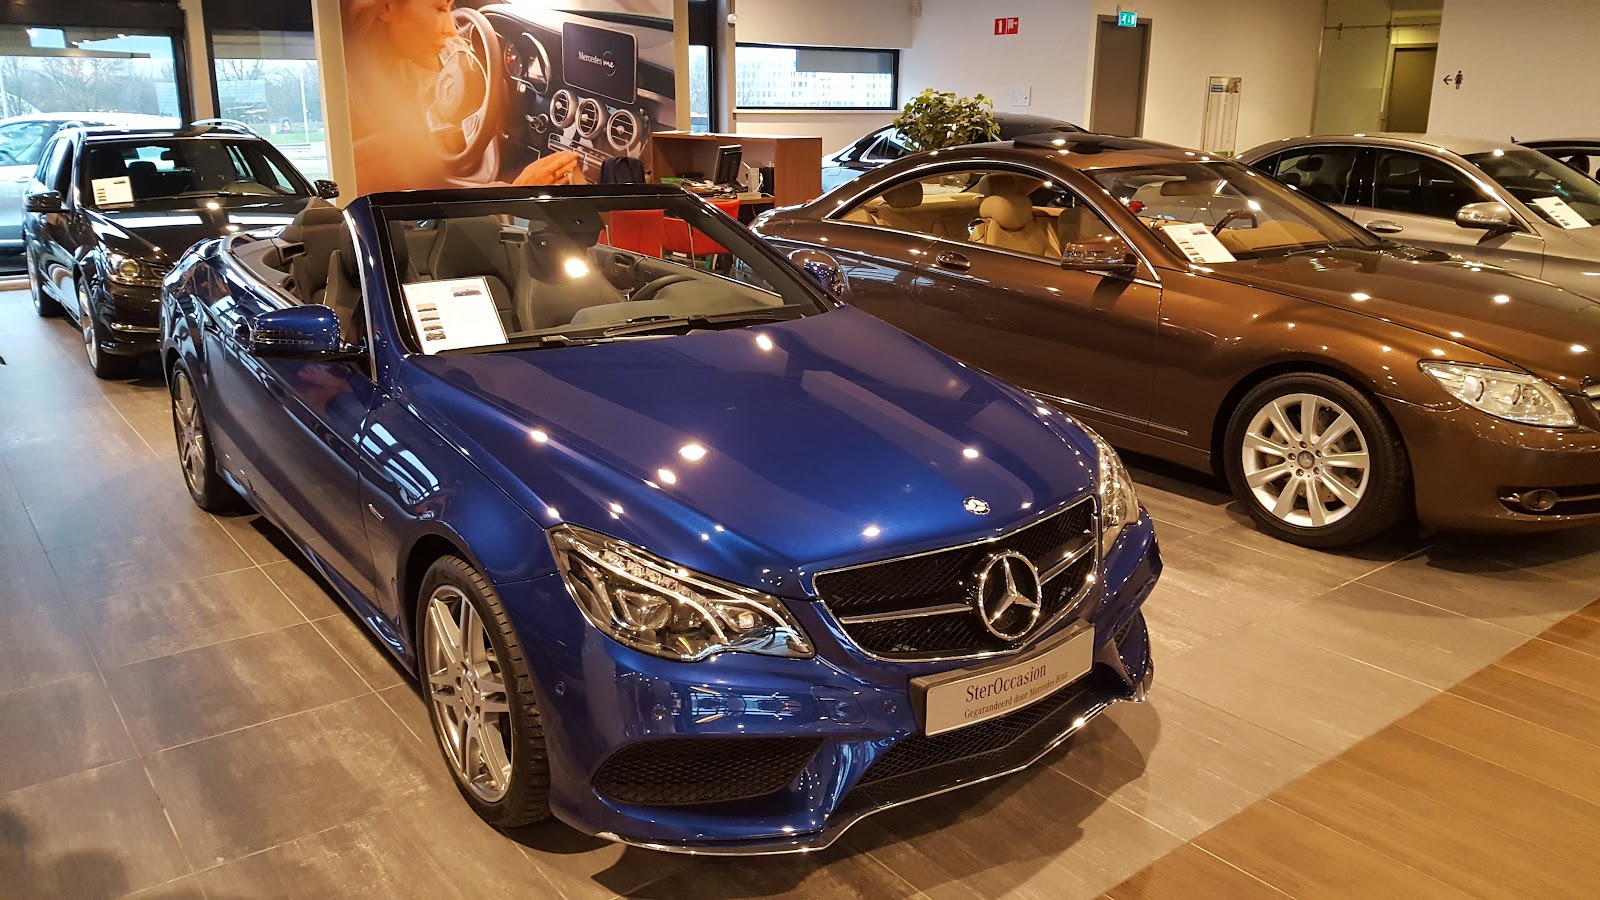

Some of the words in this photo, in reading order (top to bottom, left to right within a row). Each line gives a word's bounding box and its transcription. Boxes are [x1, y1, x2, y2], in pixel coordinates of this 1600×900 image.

[578, 50, 602, 65] Mercedes
[603, 60, 615, 68] me
[965, 664, 1047, 703] SterOccasion
[964, 696, 1013, 719] Gegarandeerd
[1013, 692, 1029, 704] door
